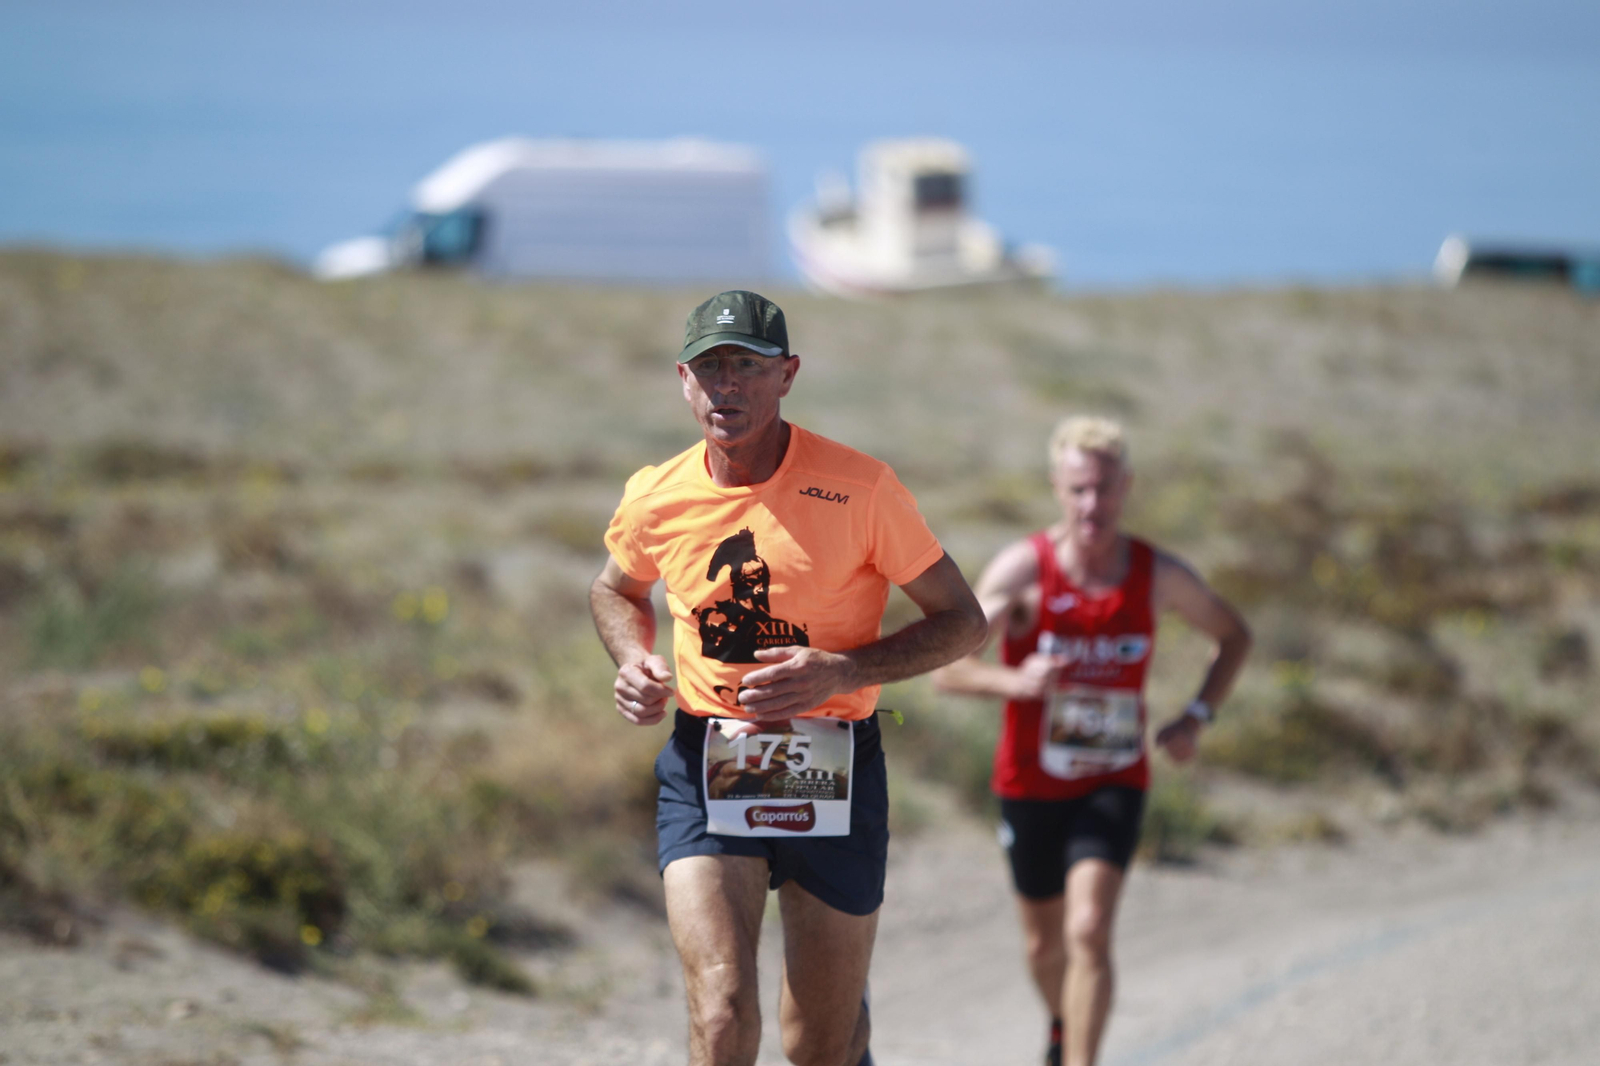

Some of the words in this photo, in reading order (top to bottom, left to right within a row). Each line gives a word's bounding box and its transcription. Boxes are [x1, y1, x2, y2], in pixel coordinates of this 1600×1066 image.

[755, 621, 794, 636] XIII
[756, 637, 798, 646] CARRERA
[727, 732, 813, 773] 175
